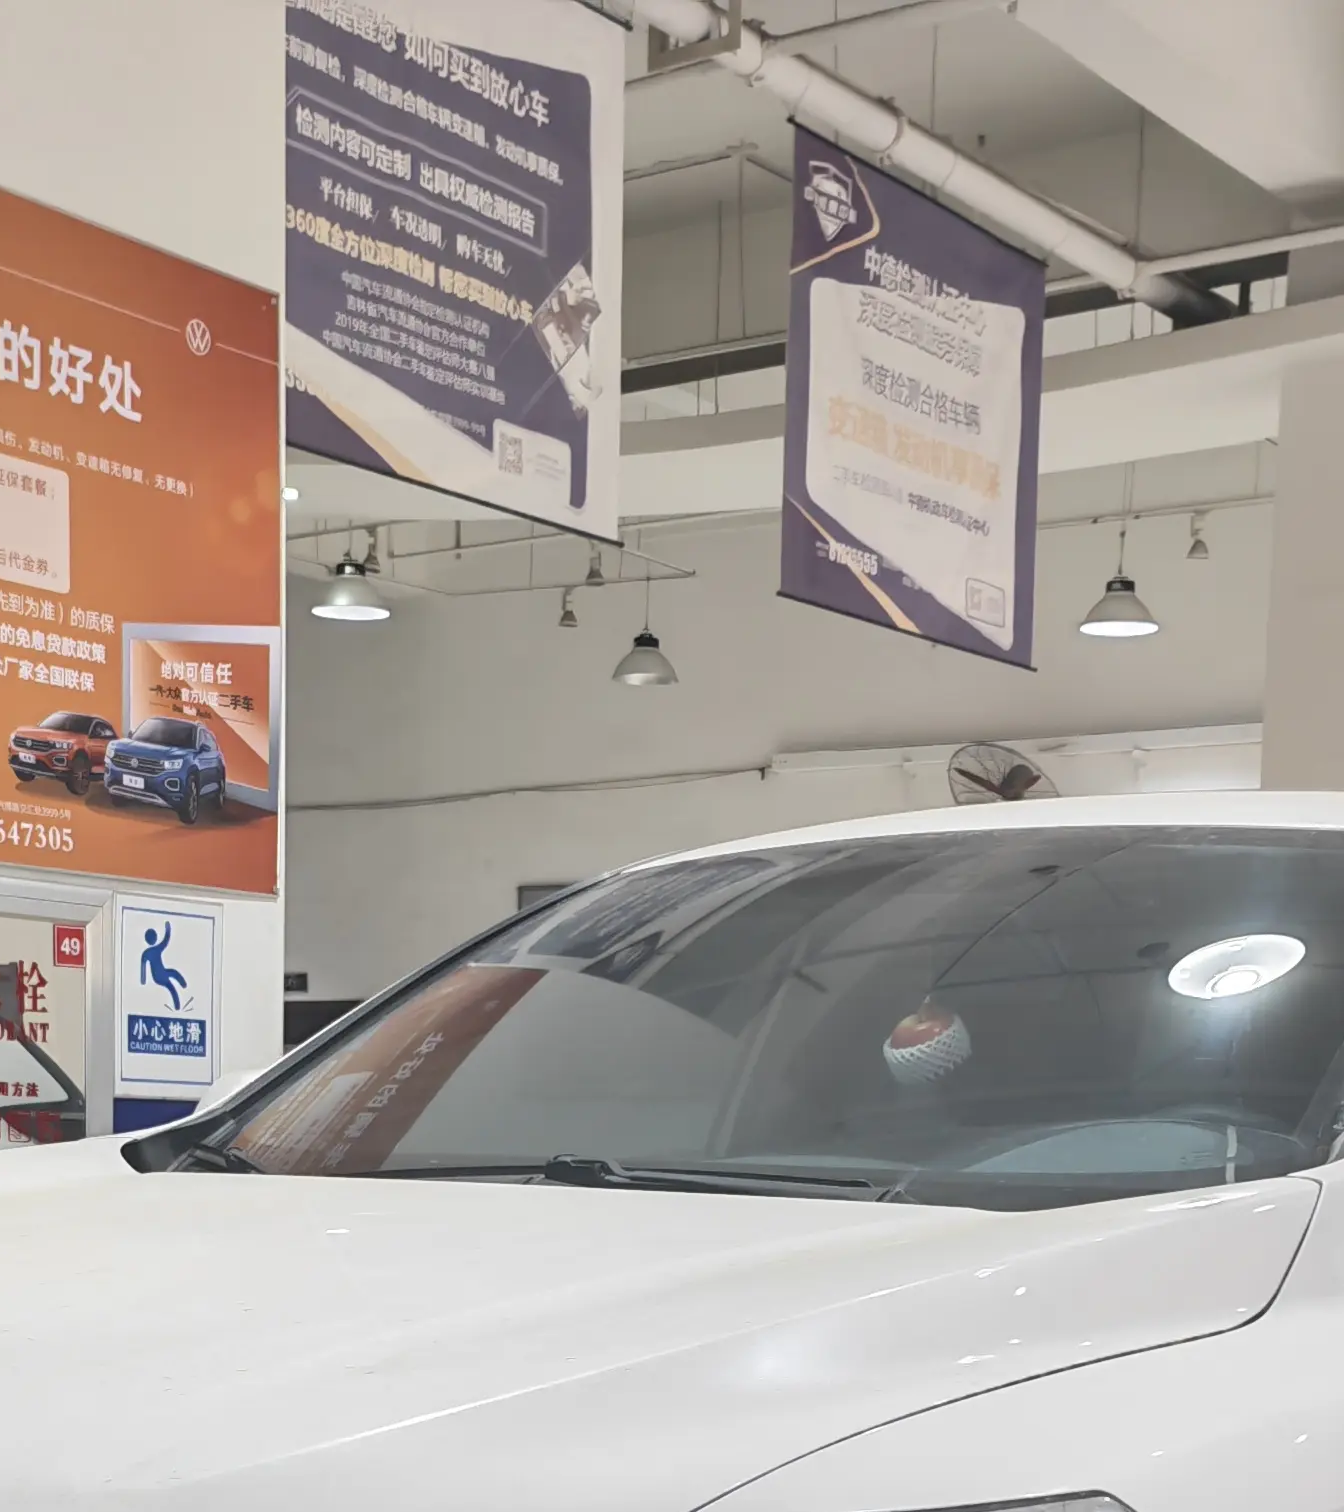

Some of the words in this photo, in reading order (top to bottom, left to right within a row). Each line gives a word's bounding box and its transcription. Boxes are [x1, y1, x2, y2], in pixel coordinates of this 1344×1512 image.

[60, 936, 81, 957] 49
[132, 1018, 202, 1044] 小心地滑
